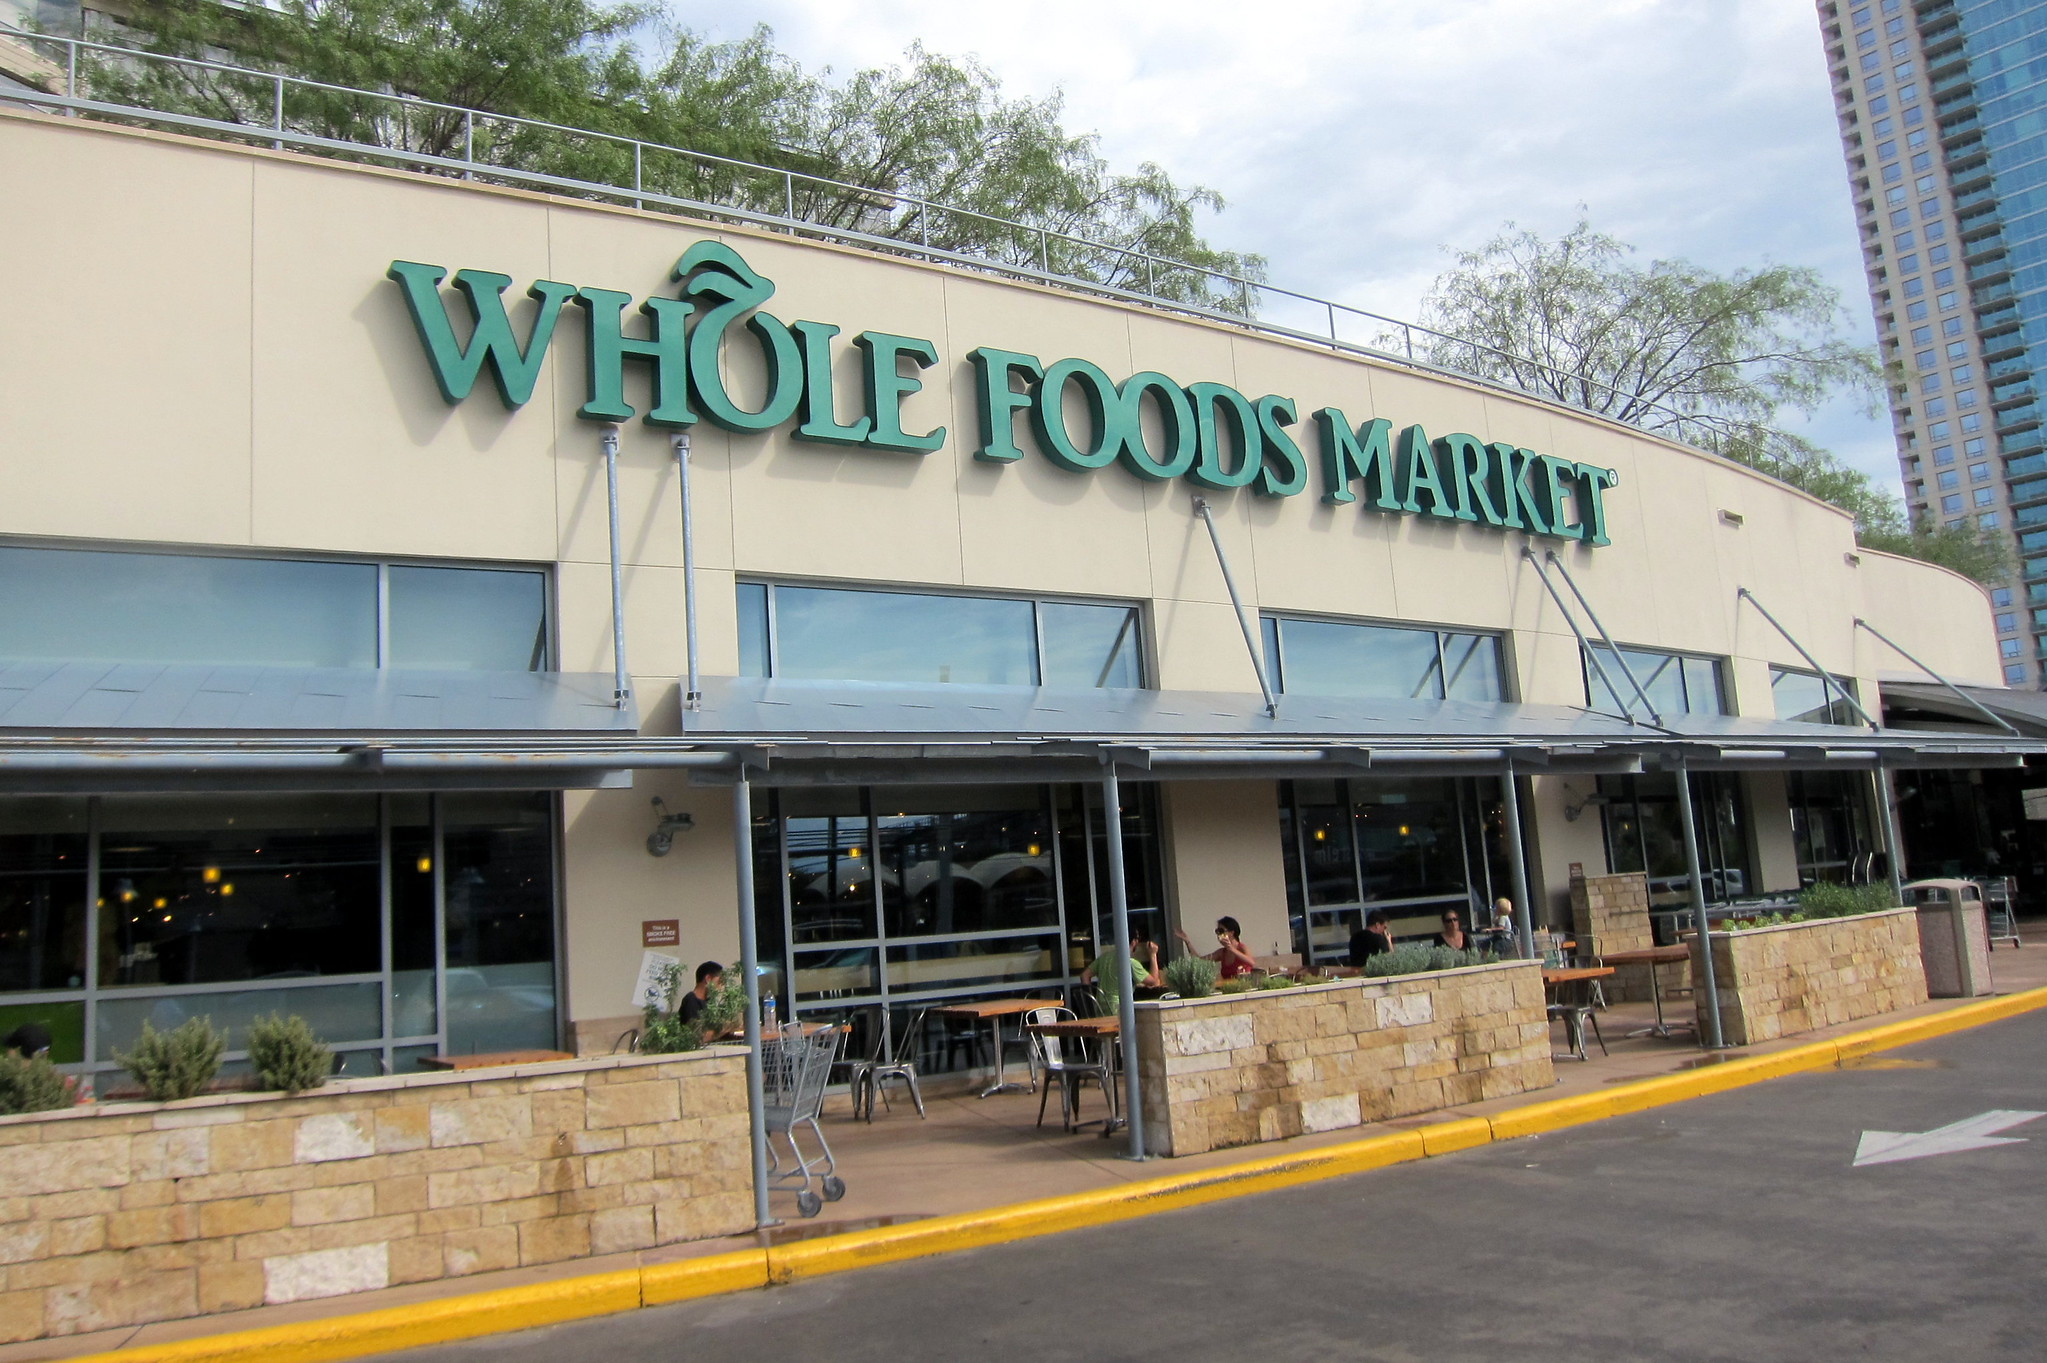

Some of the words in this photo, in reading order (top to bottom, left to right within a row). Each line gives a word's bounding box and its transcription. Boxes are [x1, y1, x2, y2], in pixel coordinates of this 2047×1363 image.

[386, 240, 946, 454] WHOLE
[967, 346, 1306, 499] FOODS
[1312, 406, 1611, 548] MARKET
